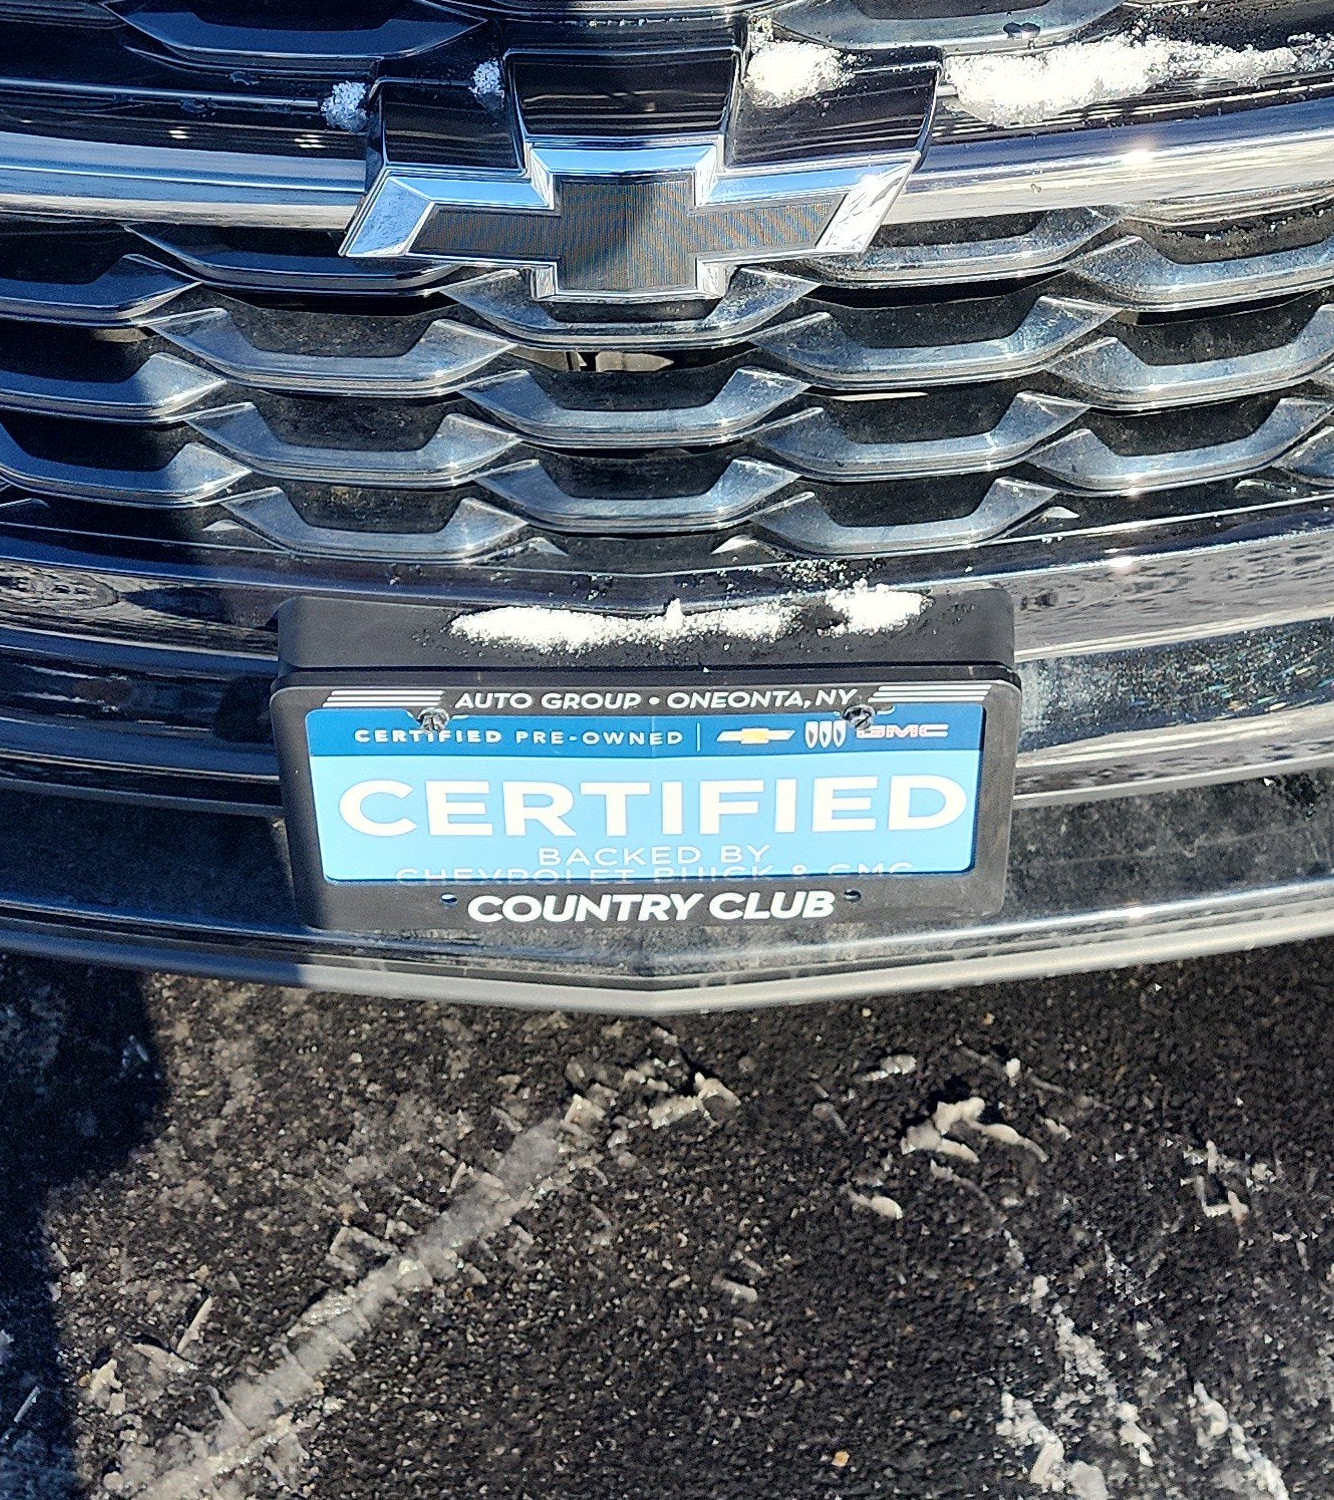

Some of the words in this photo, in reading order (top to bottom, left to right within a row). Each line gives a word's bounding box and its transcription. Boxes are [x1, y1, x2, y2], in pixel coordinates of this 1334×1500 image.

[454, 692, 533, 710] AUTO
[540, 692, 643, 710] GROUP
[354, 729, 503, 744] CERTIFIED
[516, 730, 683, 746] PRE-OWNED
[856, 722, 949, 739] GMC
[339, 774, 968, 838] CERTIFIED
[538, 846, 701, 867] BACKED
[720, 844, 771, 864] BY
[467, 892, 705, 923] COUNTRY
[709, 890, 836, 921] CLUB
